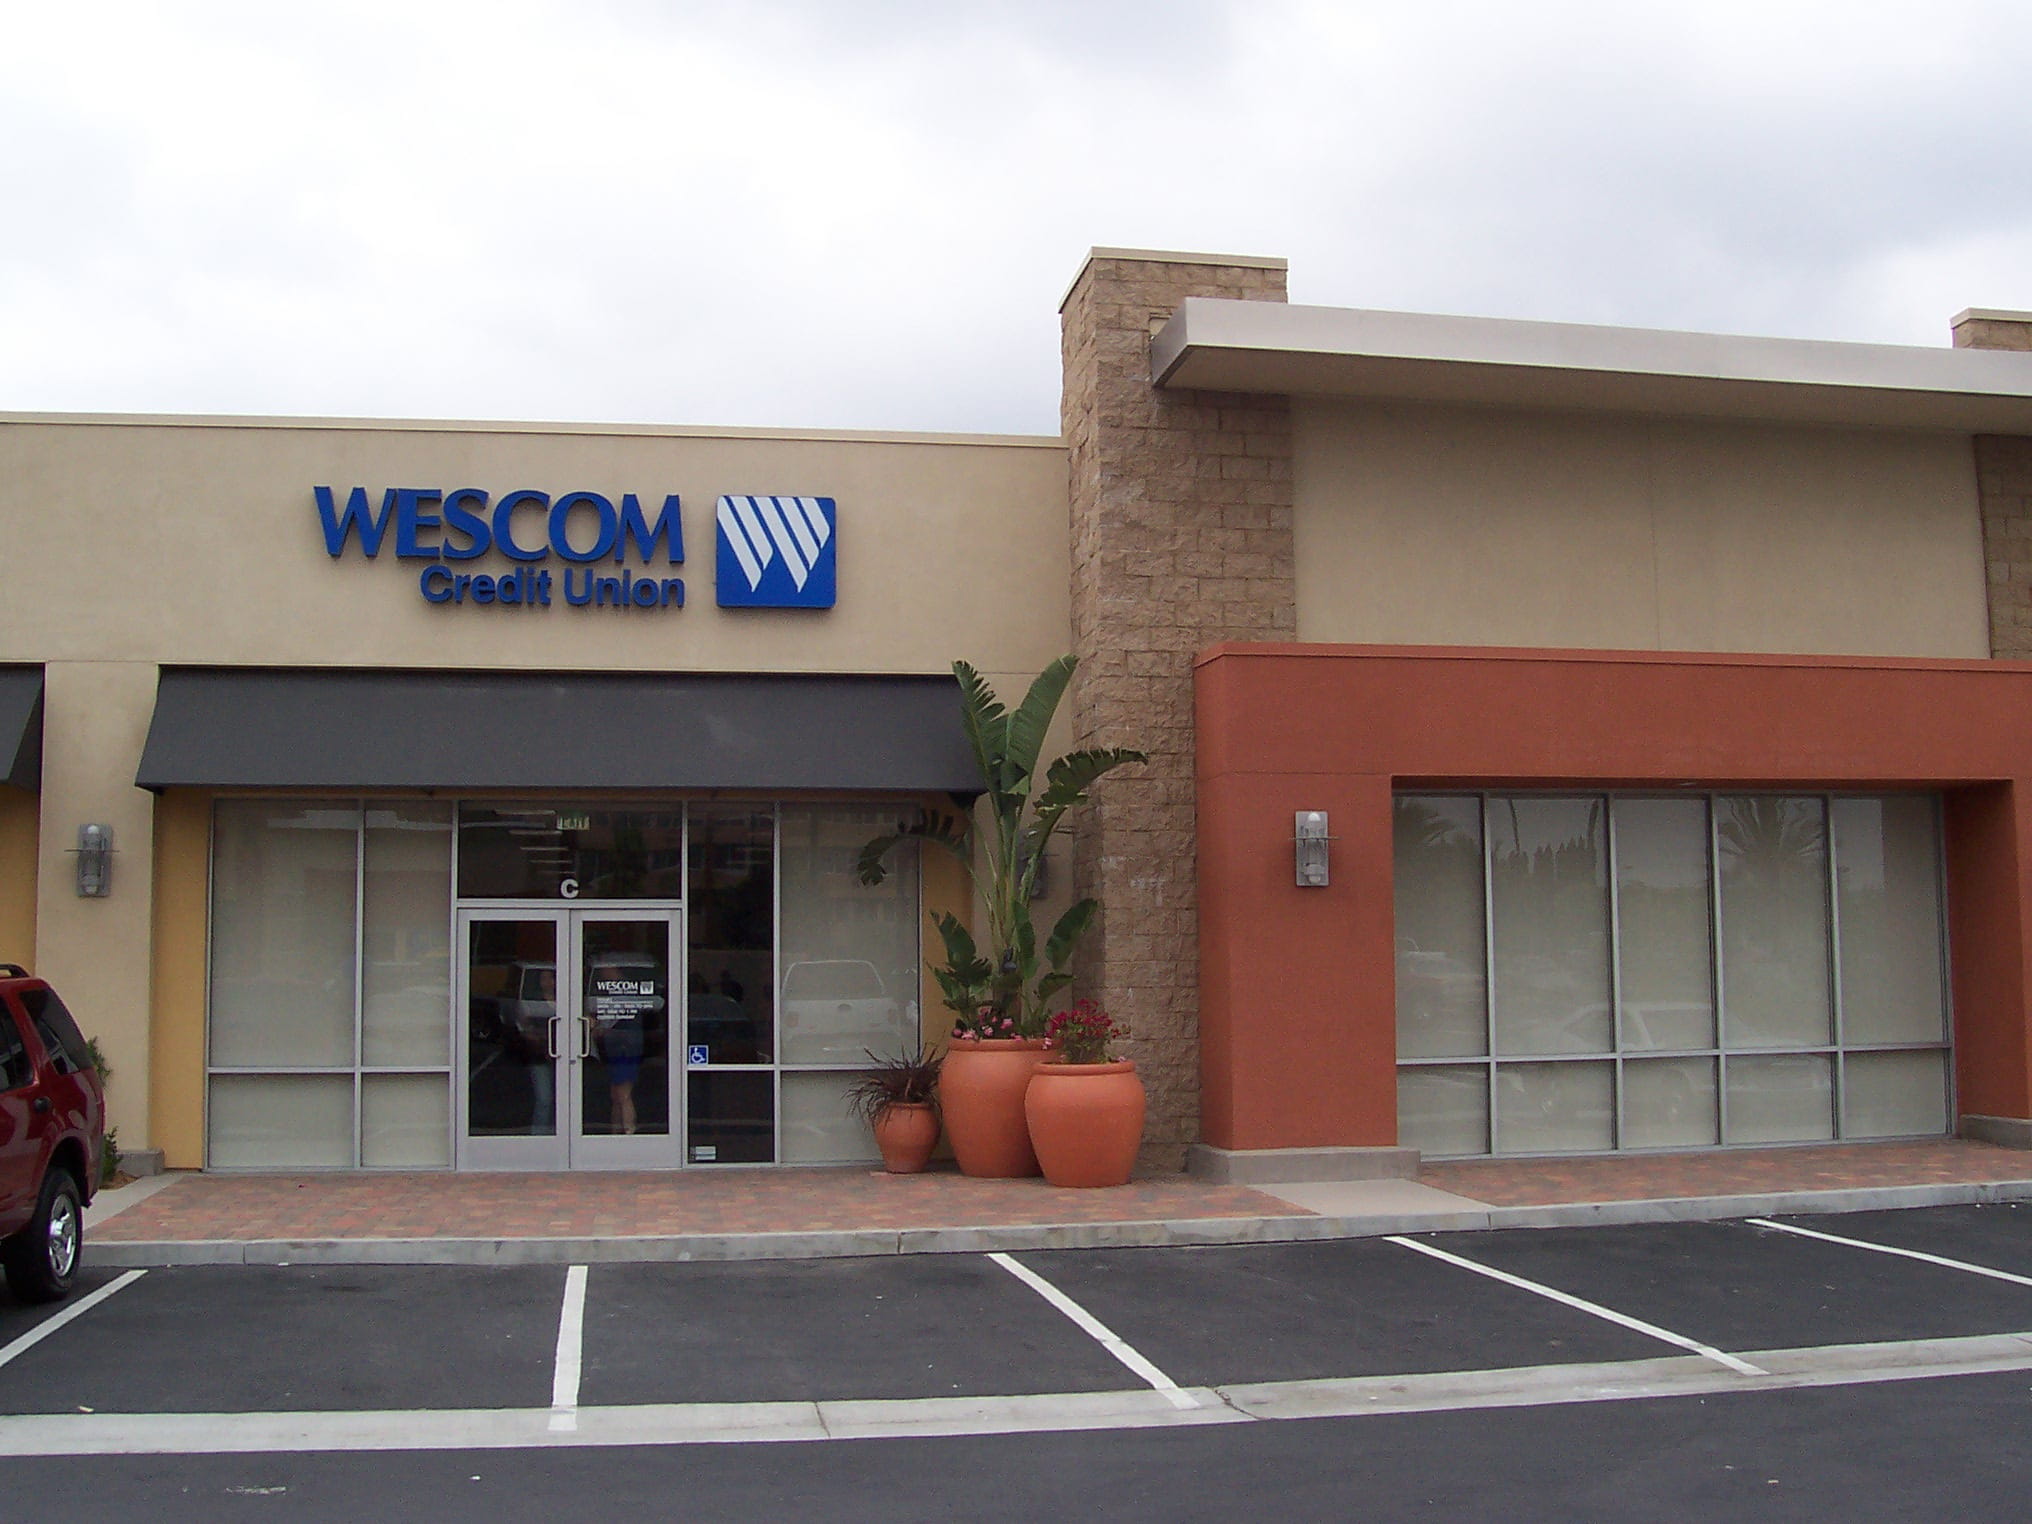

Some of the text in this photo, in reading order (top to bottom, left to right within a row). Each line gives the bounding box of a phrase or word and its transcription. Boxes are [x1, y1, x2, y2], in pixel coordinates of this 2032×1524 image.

[313, 486, 685, 564] WESCOM
[420, 565, 685, 609] Credit Union
[560, 878, 579, 899] C
[596, 981, 638, 991] WESCOM
